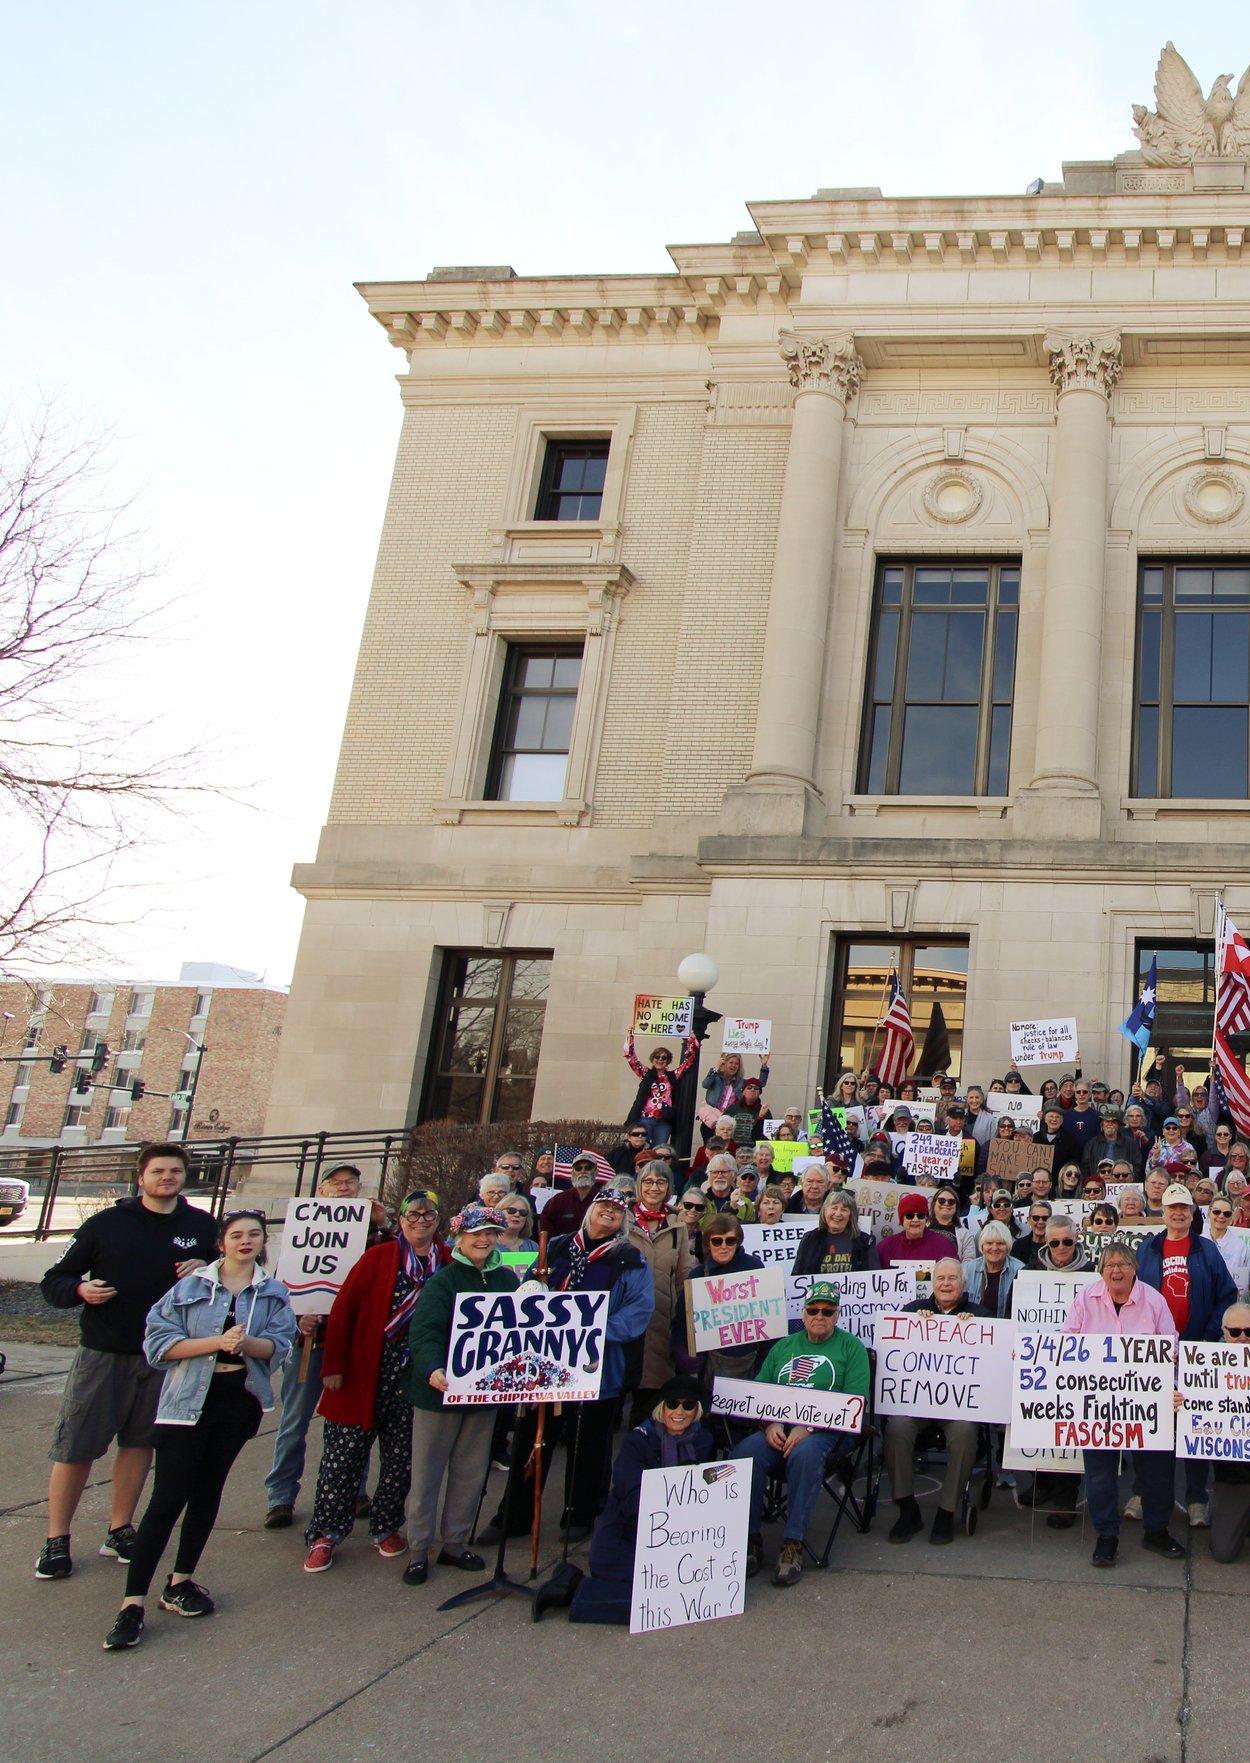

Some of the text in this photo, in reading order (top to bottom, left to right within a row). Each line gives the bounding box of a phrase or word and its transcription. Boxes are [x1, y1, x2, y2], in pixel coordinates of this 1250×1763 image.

[638, 999, 690, 1011] HATE HAS
[637, 1011, 689, 1023] NO HOME
[736, 1020, 759, 1034] Trump
[650, 1024, 673, 1034] HERE
[1012, 1024, 1020, 1032] No
[1024, 1029, 1046, 1039] justice
[1060, 1025, 1068, 1035] all
[1045, 1034, 1072, 1043] balances
[1015, 1053, 1035, 1062] under
[1008, 1101, 1022, 1111] NO
[912, 1134, 958, 1148] 249 years
[996, 1140, 1020, 1152] YOU
[909, 1145, 960, 1158] of DEMOCRACY
[914, 1154, 953, 1167] 1 year of
[991, 1152, 1050, 1169] MAKE THIS
[906, 1162, 948, 1177] FASCISM
[295, 1202, 365, 1223] C'MON
[885, 1213, 895, 1222] of
[1064, 1204, 1073, 1215] I
[292, 1226, 349, 1248] JOIN
[762, 1228, 804, 1242] FREE
[302, 1254, 338, 1274] US
[705, 1275, 759, 1304] Worst
[872, 1274, 890, 1297] Up
[457, 1294, 606, 1329] SASSY
[693, 1297, 783, 1331] PRESIDENT
[719, 1319, 769, 1346] EVER
[882, 1317, 994, 1346] IMPEACH
[452, 1328, 602, 1378] GRANNYS
[1020, 1335, 1173, 1366] 3/4/26 1 YEAR
[1184, 1346, 1205, 1365] We
[1211, 1350, 1238, 1366] are
[885, 1349, 980, 1375] CONVICT
[1020, 1366, 1162, 1392] 52 consecutive
[1184, 1368, 1218, 1388] until
[447, 1390, 599, 1403] OF THE CHIPPEWA VALLEY
[880, 1377, 980, 1408] REMOVE
[711, 1394, 755, 1415] Regret
[1020, 1394, 1157, 1434] weeks Fighting
[1184, 1399, 1213, 1412] come
[1055, 1421, 1144, 1448] FASCISM
[1191, 1414, 1223, 1435] Eau
[663, 1469, 738, 1507] Who is
[646, 1511, 726, 1548] Bearing
[641, 1551, 738, 1590] the Cost of
[640, 1598, 671, 1631] this
